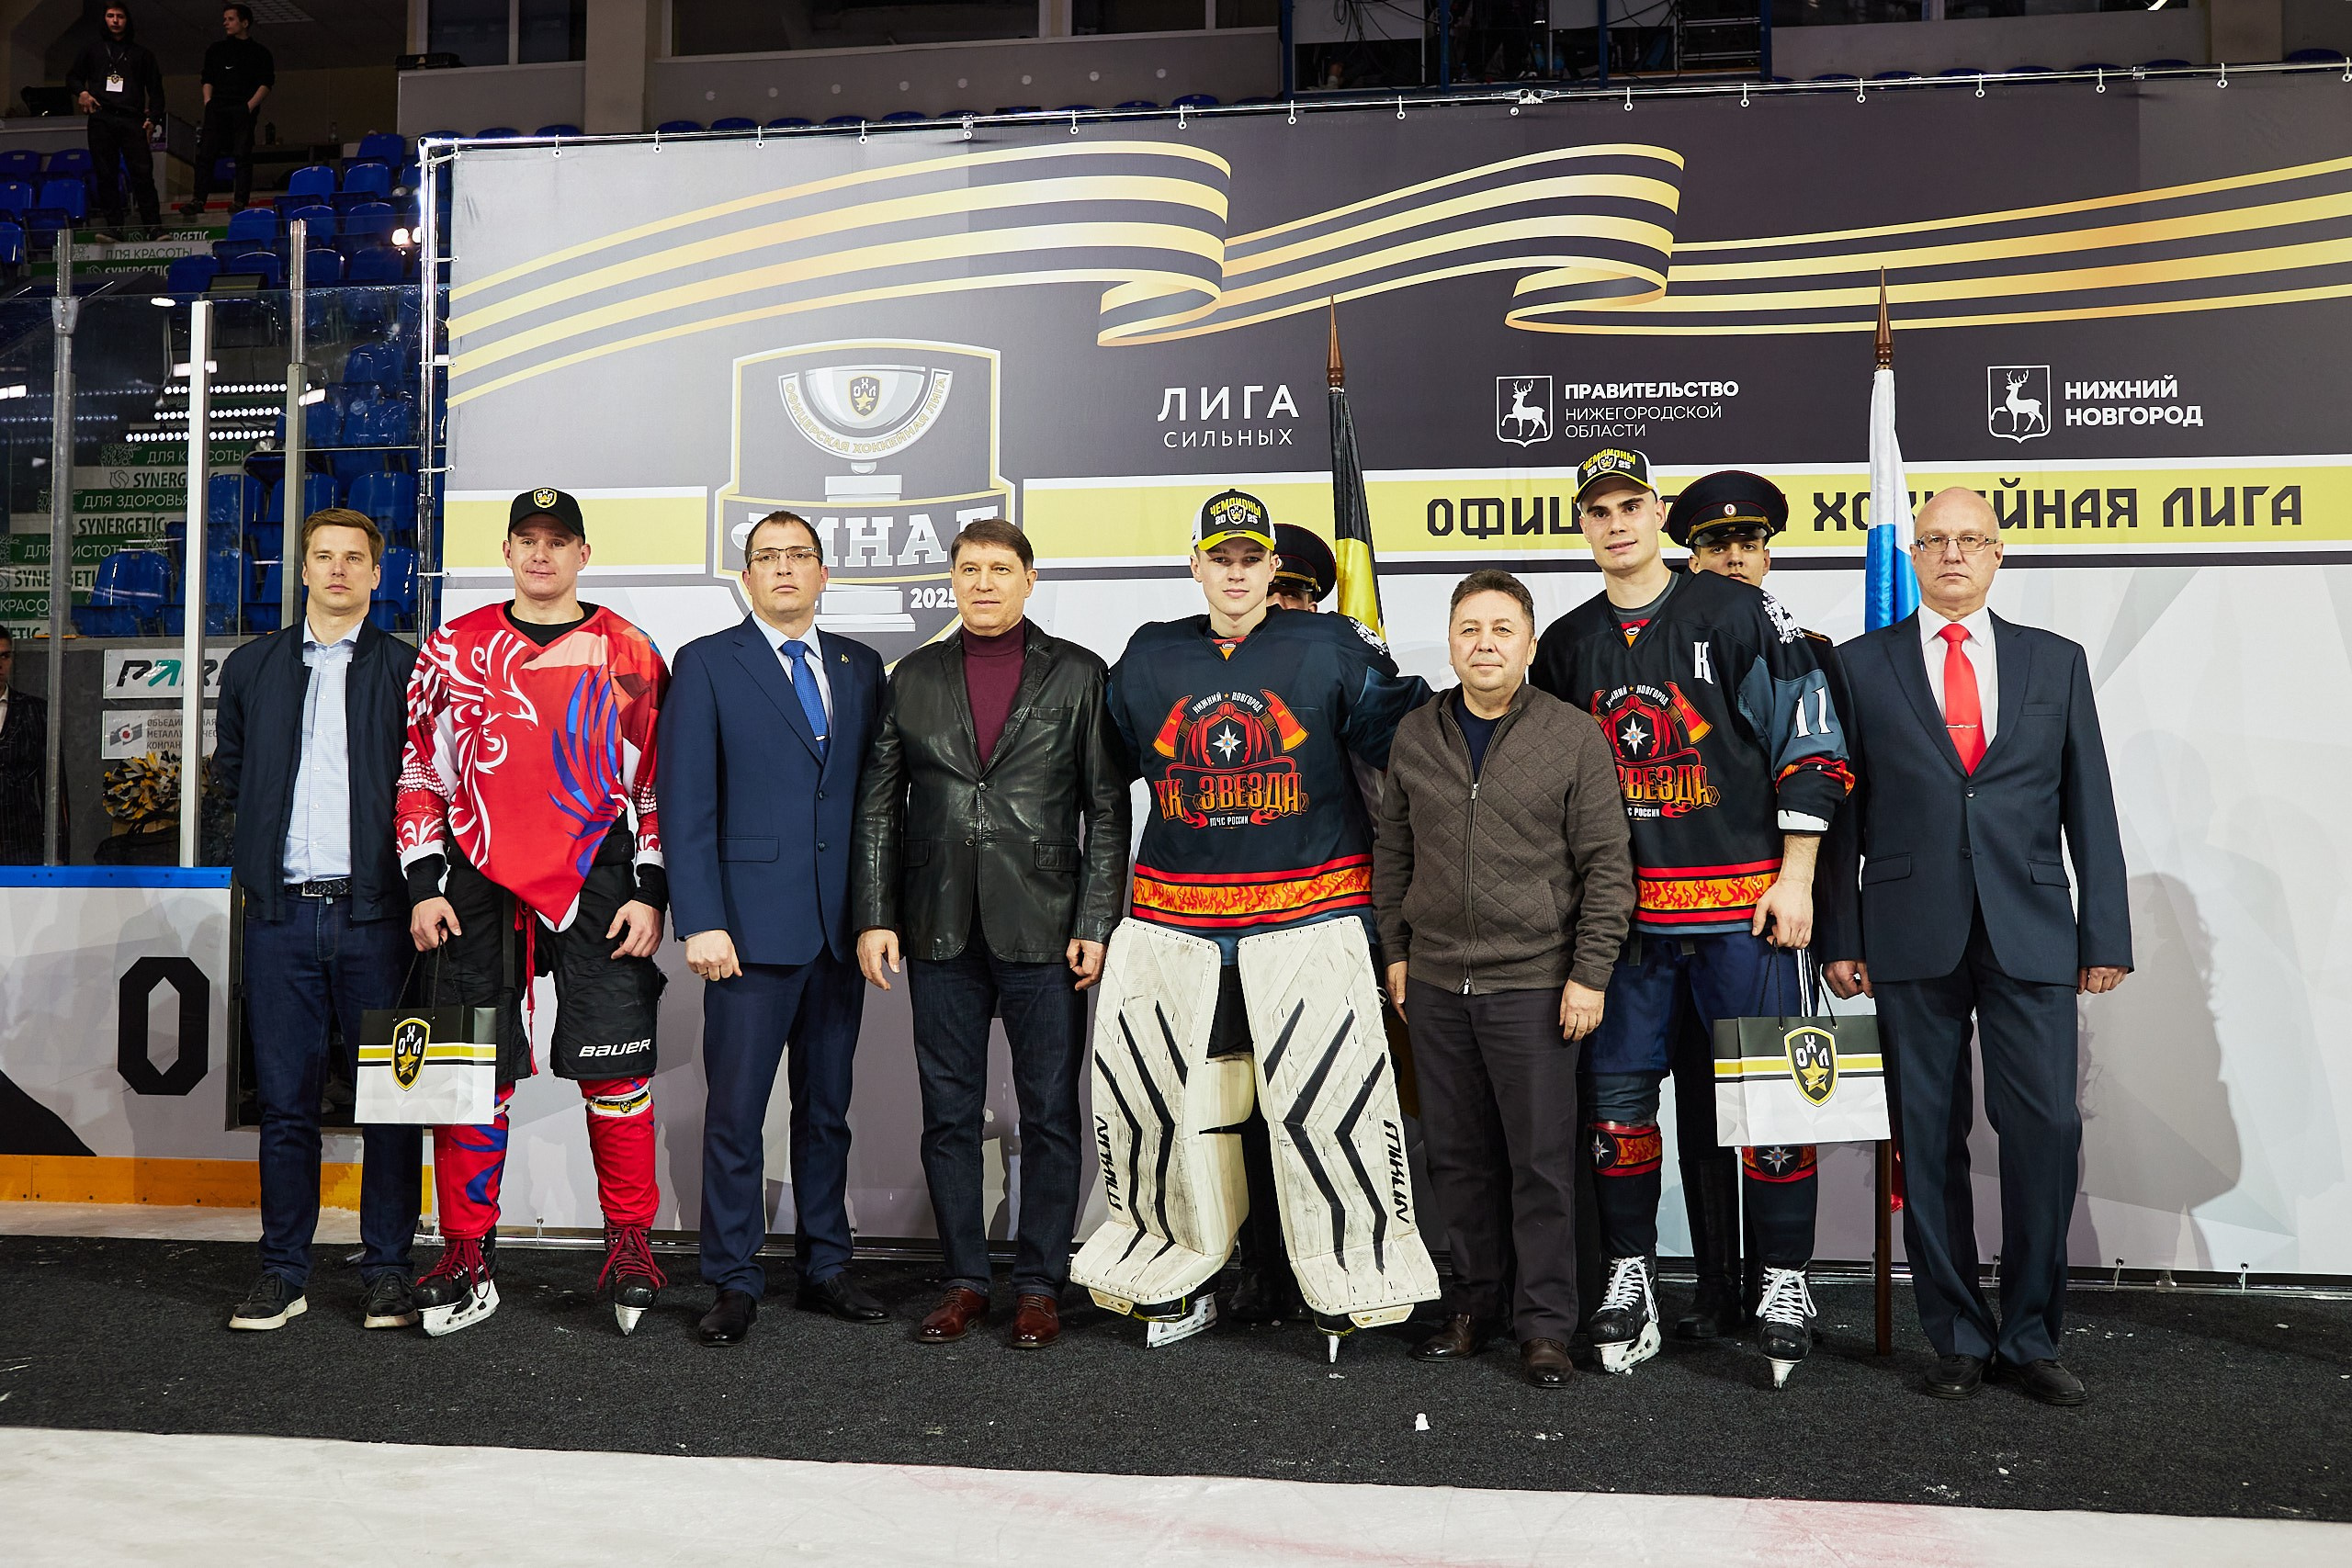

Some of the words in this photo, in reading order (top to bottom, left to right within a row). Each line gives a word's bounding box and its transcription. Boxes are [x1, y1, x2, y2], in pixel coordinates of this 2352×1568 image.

[105, 248, 130, 260] ДЛЯ
[1565, 380, 1739, 400] ПРАВИТЕЛЬСТВО
[2064, 374, 2178, 400] НИЖНИЙ
[1157, 384, 1300, 422] ЛИГА
[1565, 401, 1723, 422] НИЖЕГОРОДСКОЙ
[785, 383, 850, 452] ОФИЦЕРСКАЯ
[852, 412, 929, 453] ХОККЕЙНАЯ
[926, 378, 946, 413] ЛИГА
[2064, 405, 2204, 427] НОВГОРОД
[1163, 428, 1293, 448] СИЛЬНЫХ
[1565, 423, 1646, 439] ОБЛАСТИ
[147, 451, 175, 464] ДЛЯ
[177, 450, 244, 462] КСОТЫ
[83, 495, 112, 508] ДЛЯ
[2162, 485, 2301, 528] ЛИГА
[79, 516, 165, 534] SYNERGETIC
[1215, 513, 1227, 525] 20
[1247, 513, 1259, 525] 25
[1694, 641, 1713, 684] К
[1193, 691, 1222, 715] НИЖНИЙ
[1231, 691, 1264, 714] НОВГОРОД
[1636, 684, 1669, 706] НОВГОРОД
[1796, 686, 1834, 738] 11
[1227, 815, 1249, 826] РОССИИ
[398, 1025, 422, 1055] ОХЛ
[1795, 1034, 1830, 1066] ОХЛ
